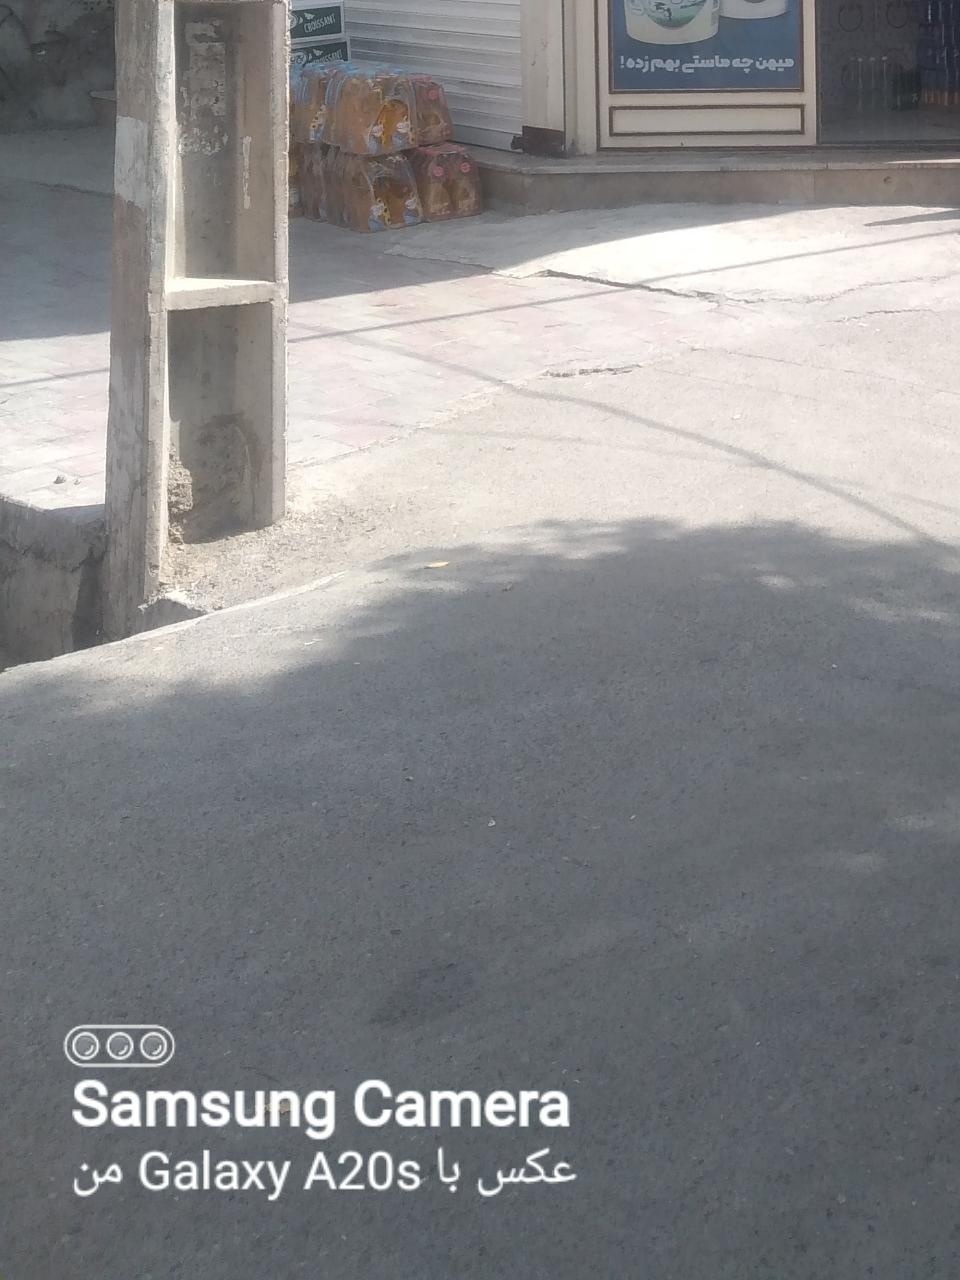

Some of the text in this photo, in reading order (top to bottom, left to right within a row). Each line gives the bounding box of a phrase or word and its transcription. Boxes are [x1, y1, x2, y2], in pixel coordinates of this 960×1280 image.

[651, 57, 681, 72] بهم
[681, 55, 731, 73] ماستی
[732, 56, 753, 73] چه
[756, 55, 795, 71] میهن
